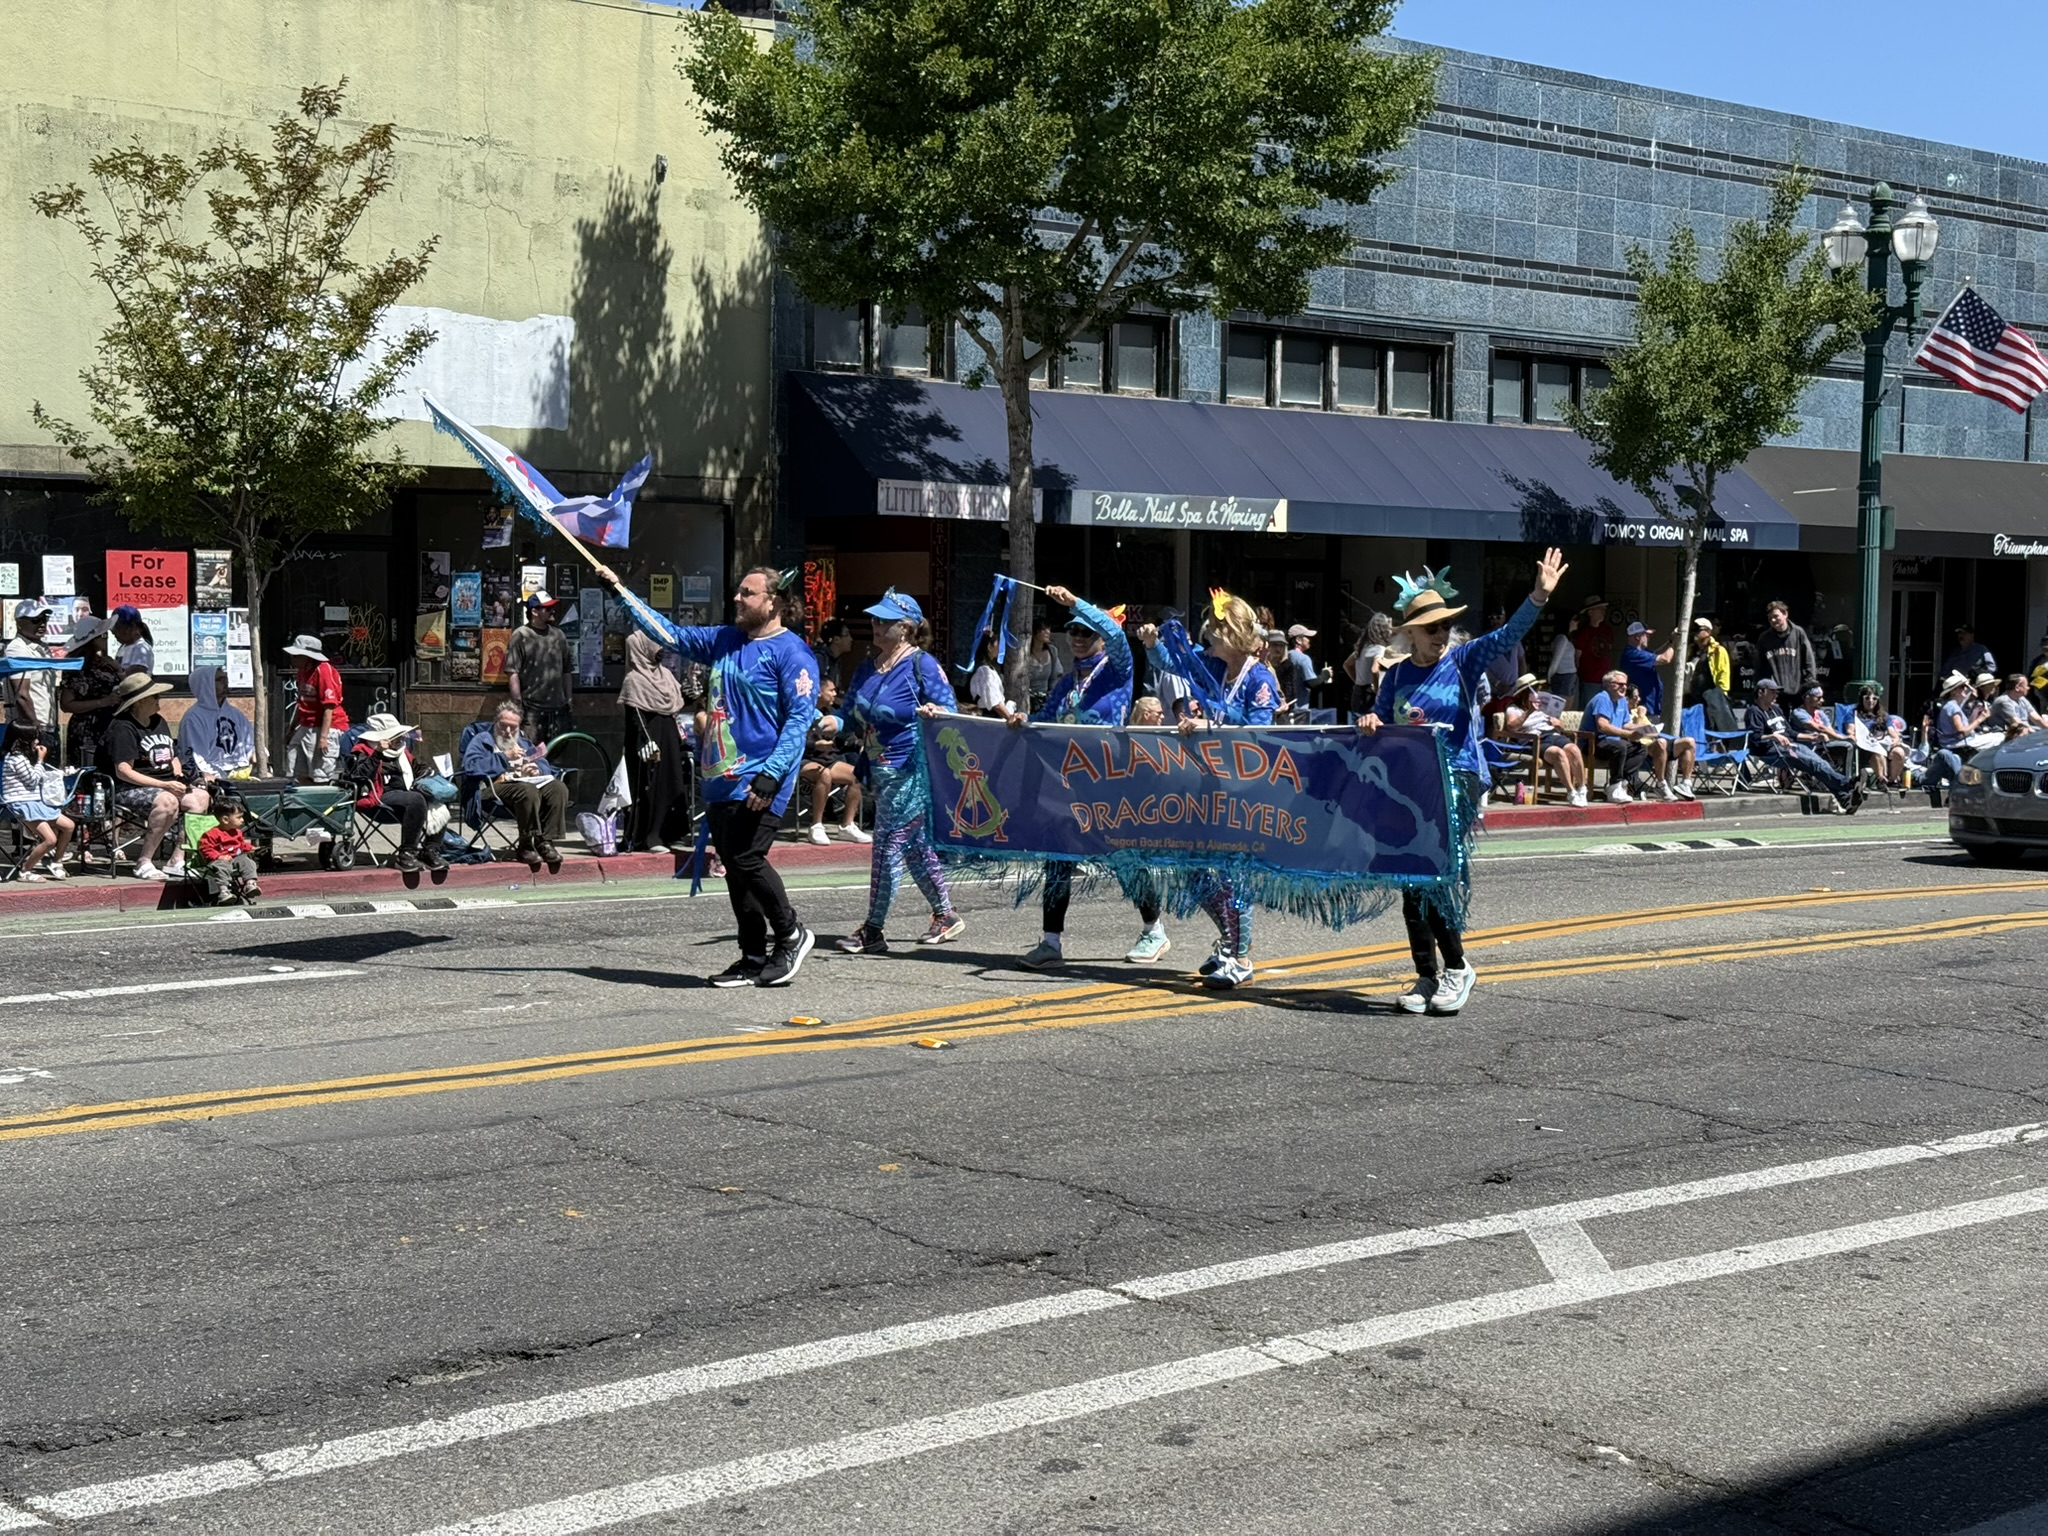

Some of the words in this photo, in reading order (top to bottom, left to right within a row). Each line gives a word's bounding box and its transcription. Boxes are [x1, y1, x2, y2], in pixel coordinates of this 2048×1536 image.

[884, 486, 935, 513] LITTLE
[1095, 494, 1138, 521] Bella
[1139, 496, 1175, 523] Nail
[1177, 499, 1202, 527] Spa
[1206, 500, 1218, 525] &
[1219, 500, 1267, 531] Waxing
[1603, 523, 1646, 539] TOMO'S
[1649, 525, 1694, 541] ORGA
[1703, 527, 1727, 542] NAIL
[1729, 528, 1749, 542] SPA
[131, 554, 165, 570] For
[119, 571, 177, 589] Lease
[653, 577, 670, 585] IMP
[112, 593, 184, 604] 415.395.7262
[1061, 737, 1303, 793] ALAMEDA
[1070, 790, 1308, 846] DRAGONFLYERS
[1104, 835, 1138, 849] Dragon
[1140, 837, 1163, 849] Boat
[1164, 837, 1194, 850] Racing
[1196, 839, 1205, 850] in
[1251, 841, 1266, 852] CA
